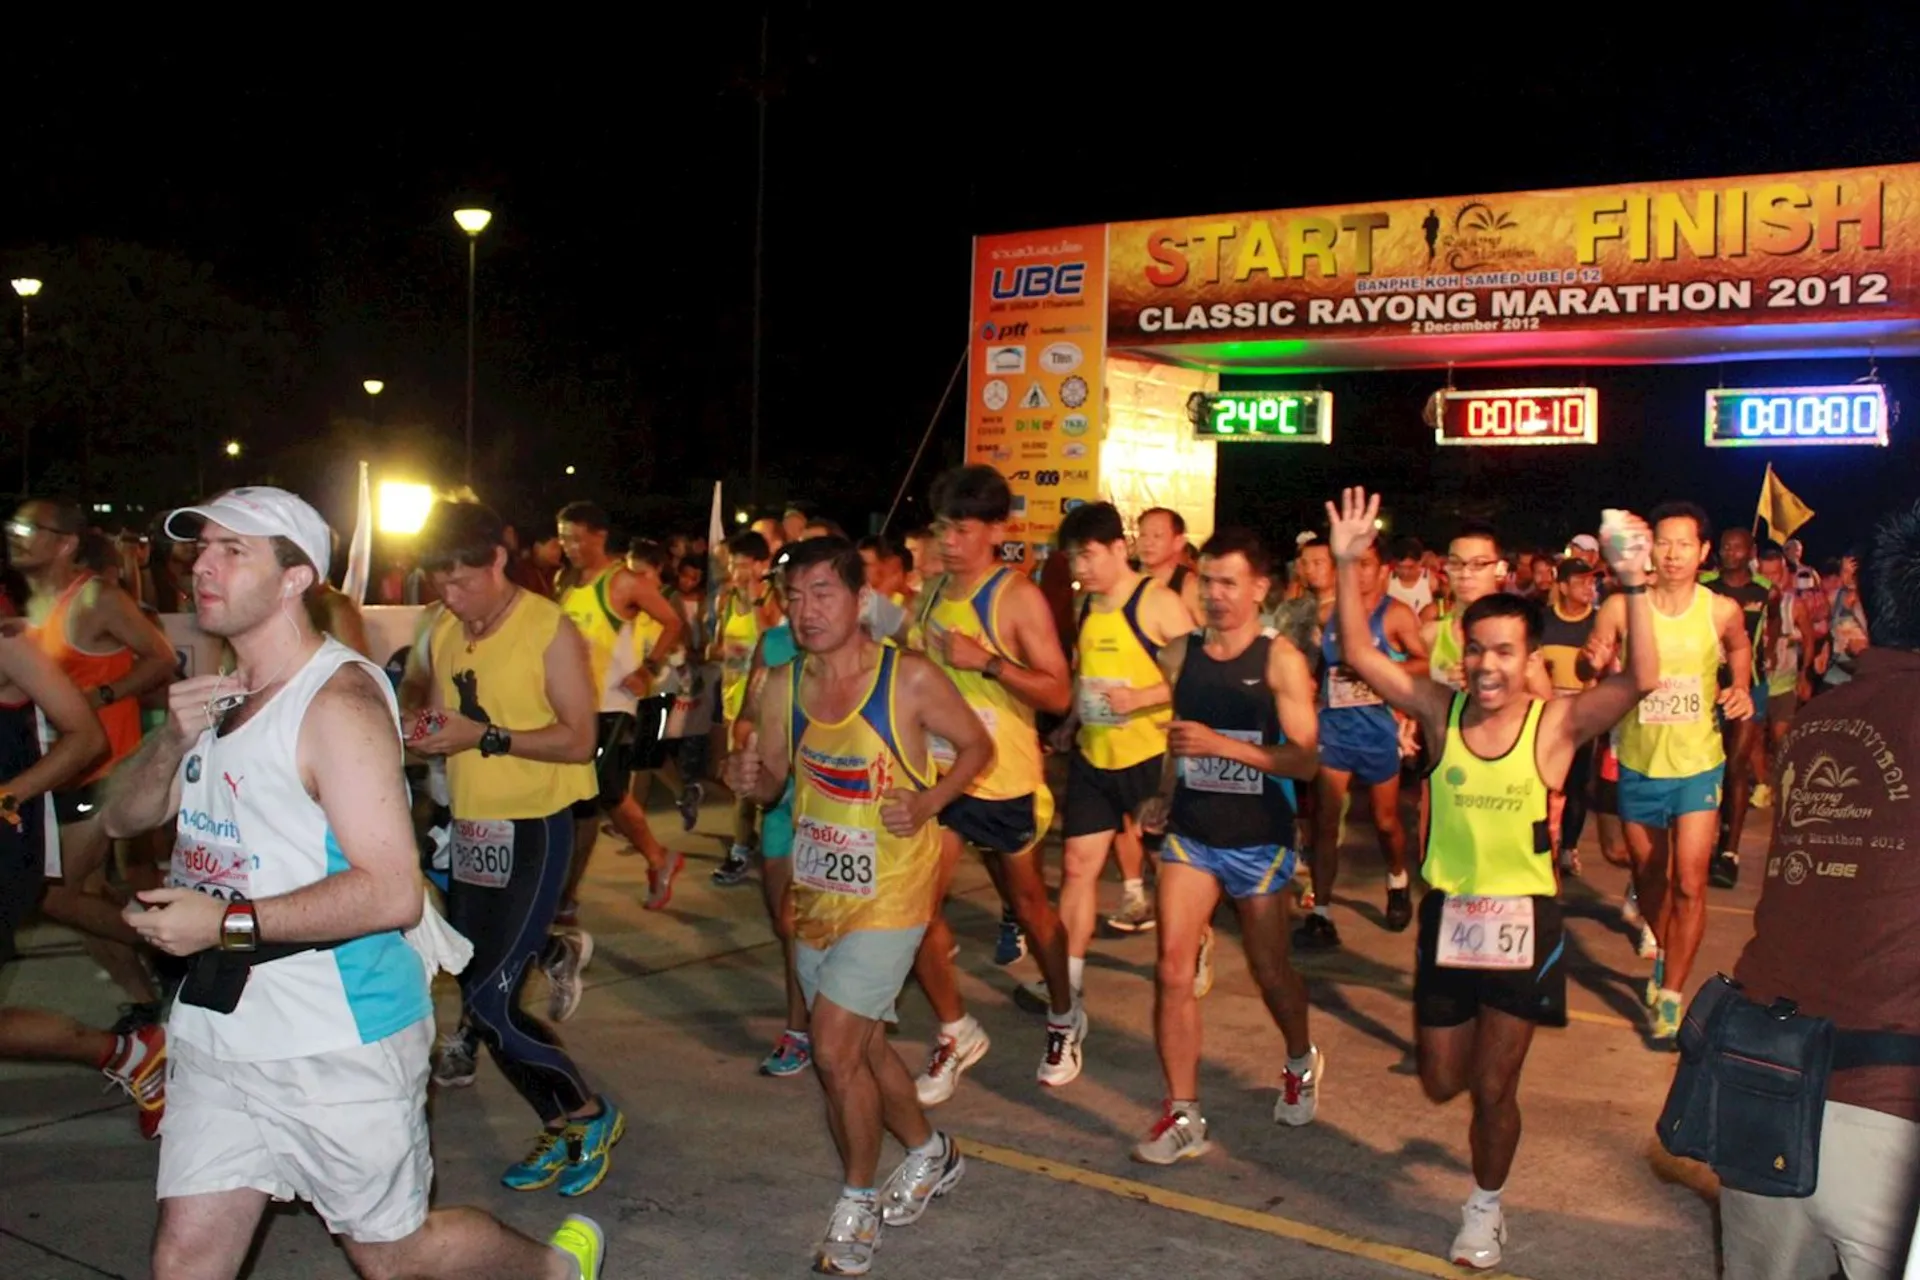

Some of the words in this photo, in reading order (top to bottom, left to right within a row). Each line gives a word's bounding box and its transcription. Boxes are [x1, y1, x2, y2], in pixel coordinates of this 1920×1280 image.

[1576, 180, 1884, 265] FINISH
[1144, 211, 1389, 288] START
[992, 262, 1087, 301] UBE
[1357, 278, 1420, 292] BANPHE
[1425, 276, 1459, 289] KOH
[1465, 272, 1521, 287] SAMED
[1526, 271, 1560, 284] UBE
[1580, 269, 1600, 282] 12
[1139, 301, 1297, 332] CLASSIC
[1308, 291, 1476, 326] RAYONG
[1491, 280, 1751, 318] MARATHON
[1767, 273, 1889, 308] 2012
[998, 321, 1029, 340] ptt
[1411, 322, 1420, 333] 2
[1425, 319, 1499, 333] December
[1502, 317, 1540, 330] 2012
[1740, 395, 1878, 436] 0:00:00
[471, 845, 511, 874] 360
[825, 852, 873, 884] 283
[1815, 861, 1859, 878] UBE
[1497, 924, 1530, 954] 57
